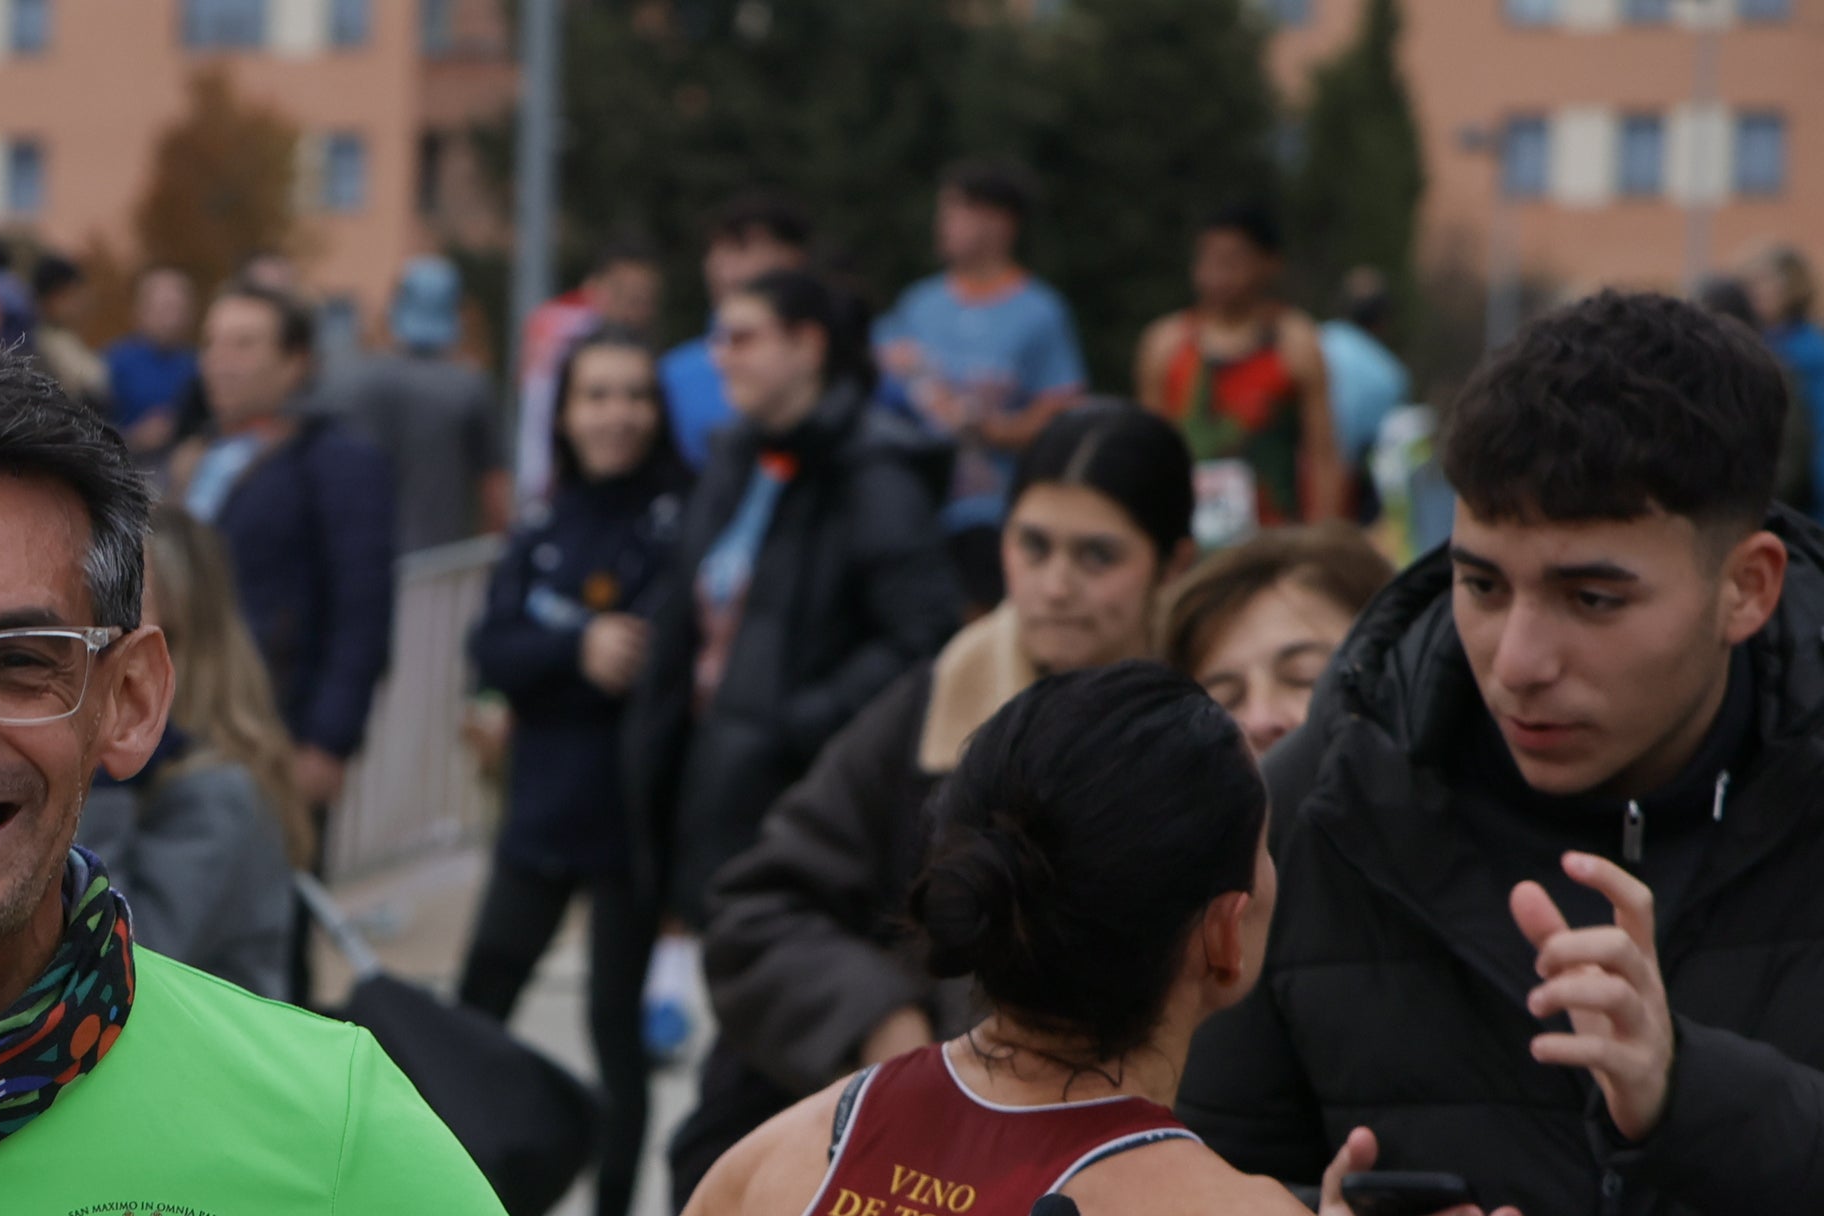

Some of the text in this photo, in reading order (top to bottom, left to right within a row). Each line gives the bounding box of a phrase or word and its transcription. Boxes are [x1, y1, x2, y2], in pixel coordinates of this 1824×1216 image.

[889, 1163, 976, 1214] VINO
[92, 1200, 138, 1214] MAXIMO
[140, 1200, 154, 1211] IN
[156, 1202, 195, 1216] OMNIA
